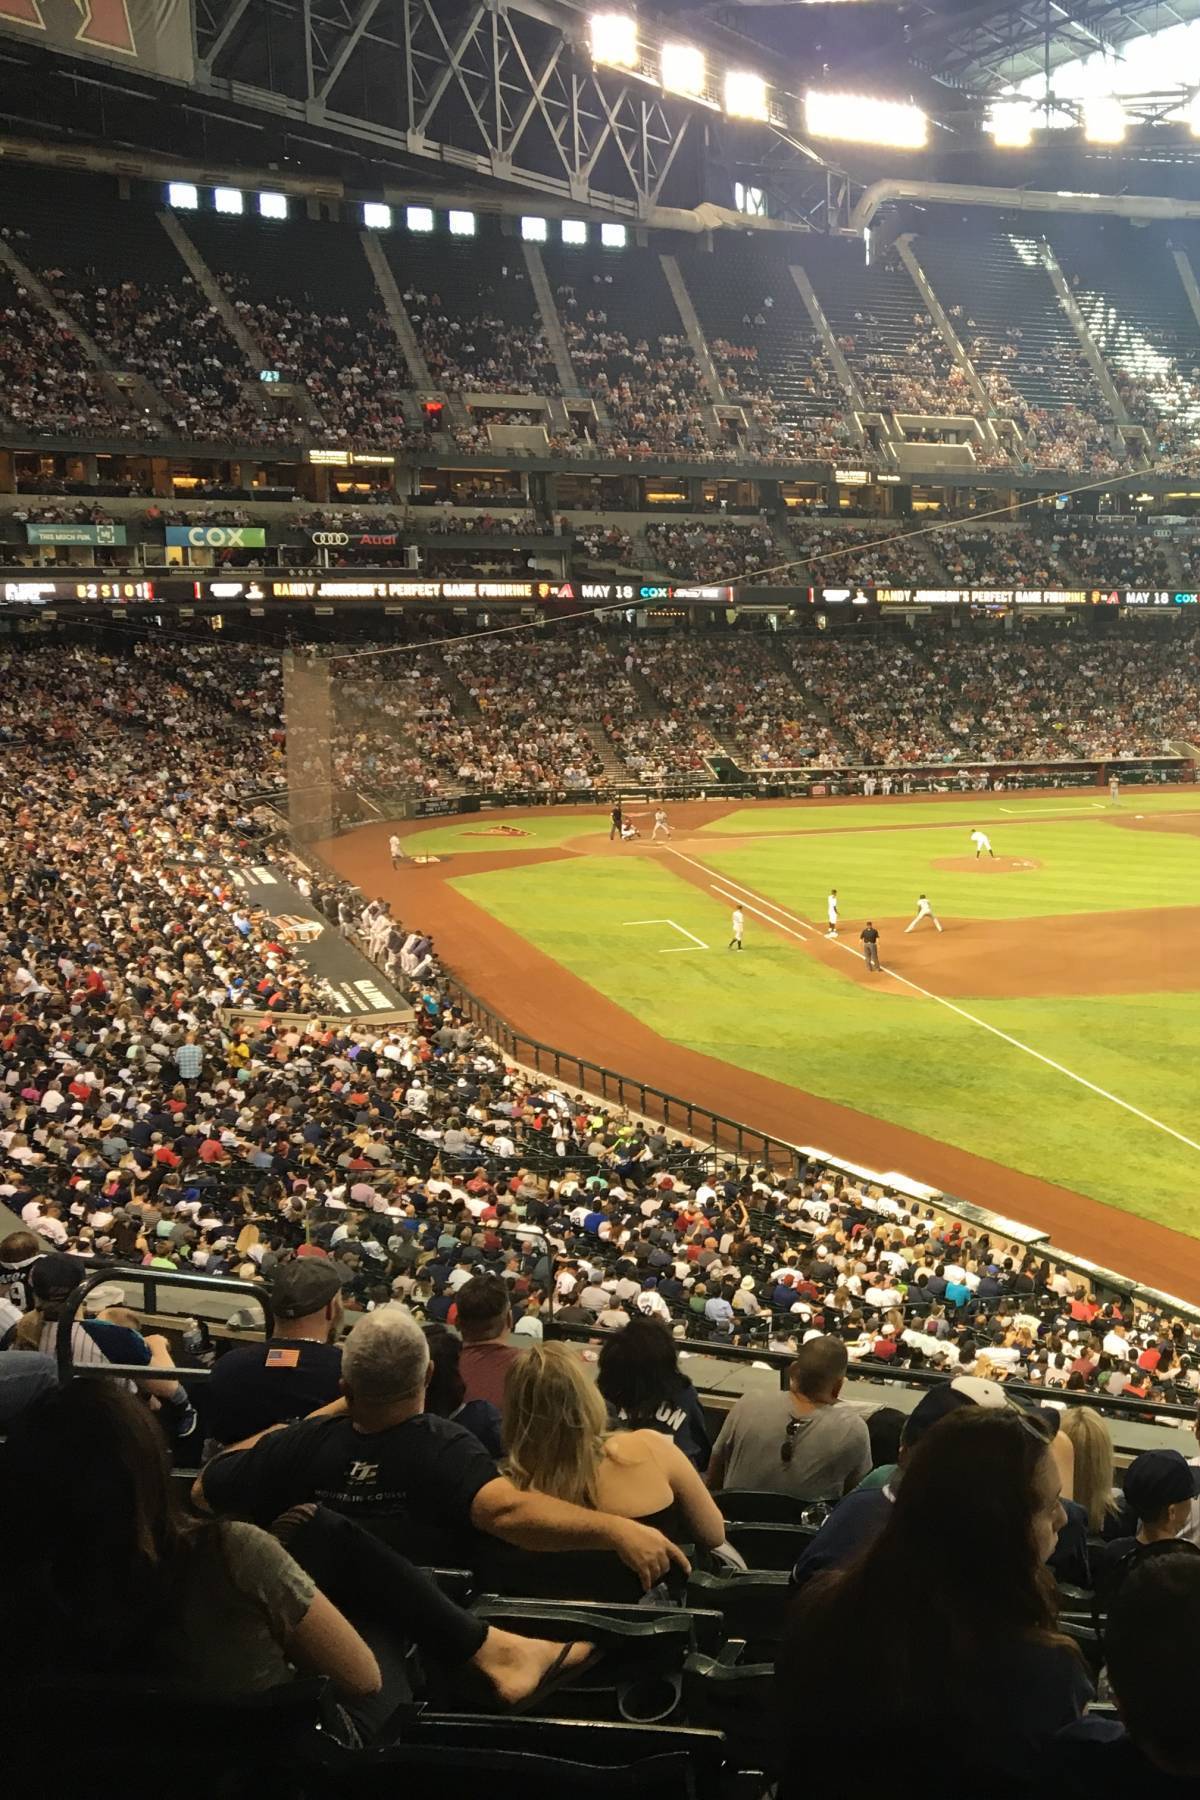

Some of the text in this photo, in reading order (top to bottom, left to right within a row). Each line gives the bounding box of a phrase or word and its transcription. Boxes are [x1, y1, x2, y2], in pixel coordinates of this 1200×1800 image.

[188, 527, 244, 546] COX
[359, 533, 396, 545] Audi
[273, 583, 315, 596] RANDY
[389, 583, 441, 596] PERFECT
[478, 583, 532, 597] FIGURINE
[582, 584, 611, 598] MAY
[616, 584, 633, 598] 18
[640, 587, 667, 598] COX
[876, 590, 911, 602] RANDY
[971, 590, 1014, 602] PERFECT
[1126, 592, 1150, 604] MAY
[1153, 592, 1169, 604] 18
[1175, 593, 1198, 603] COX
